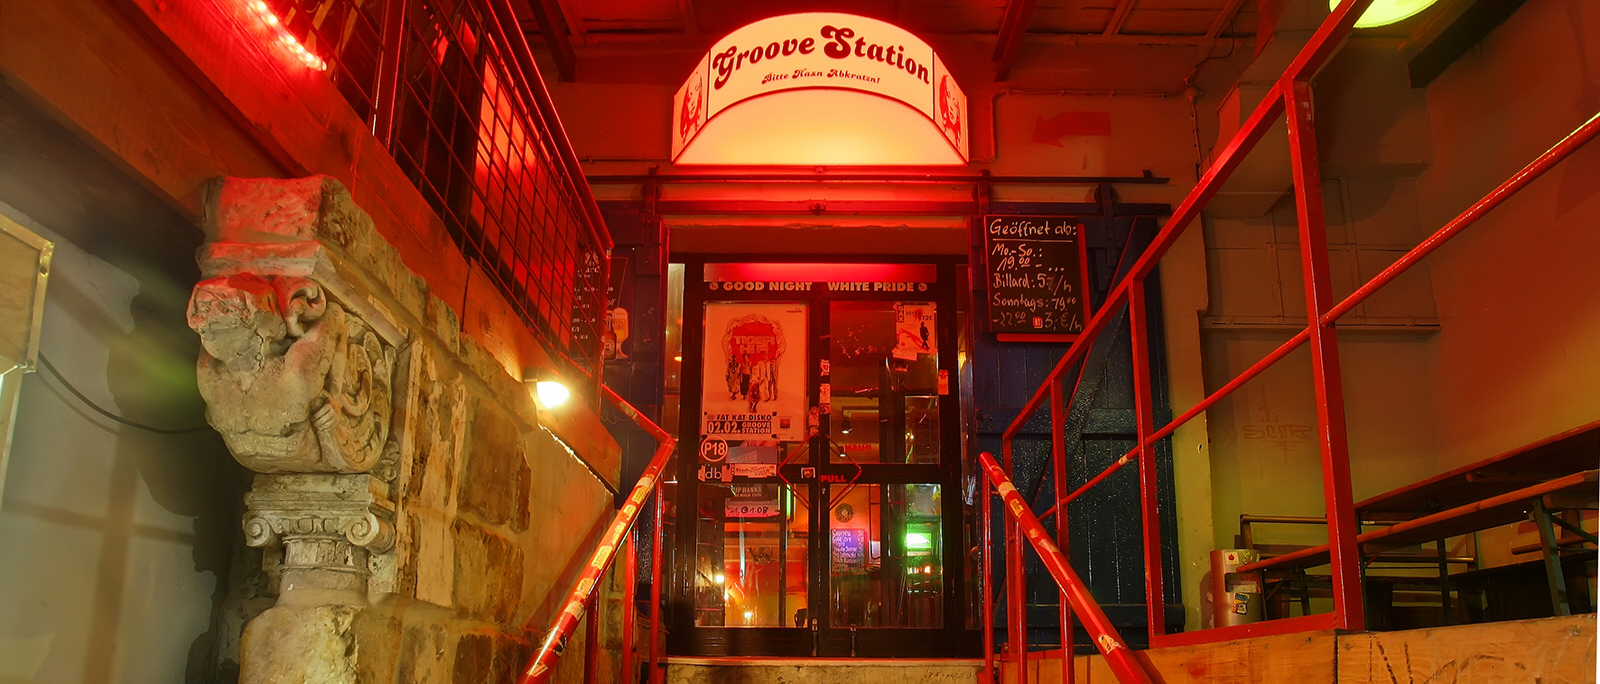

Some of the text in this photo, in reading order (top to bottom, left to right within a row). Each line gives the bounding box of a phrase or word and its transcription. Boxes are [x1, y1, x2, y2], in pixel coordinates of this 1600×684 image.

[712, 25, 930, 90] Groove Station
[761, 72, 788, 85] Bitte
[827, 68, 880, 84] Abkratzn!
[990, 218, 1077, 237] Geöffnet ab:
[723, 281, 914, 292] GOOD NIGHT WHITE PRIDE
[993, 273, 1036, 289] Billard:
[993, 292, 1049, 313] Sonntags:
[707, 421, 741, 434] 02.02.
[705, 442, 725, 456] P18
[705, 467, 722, 479] db
[820, 475, 847, 483] PULL
